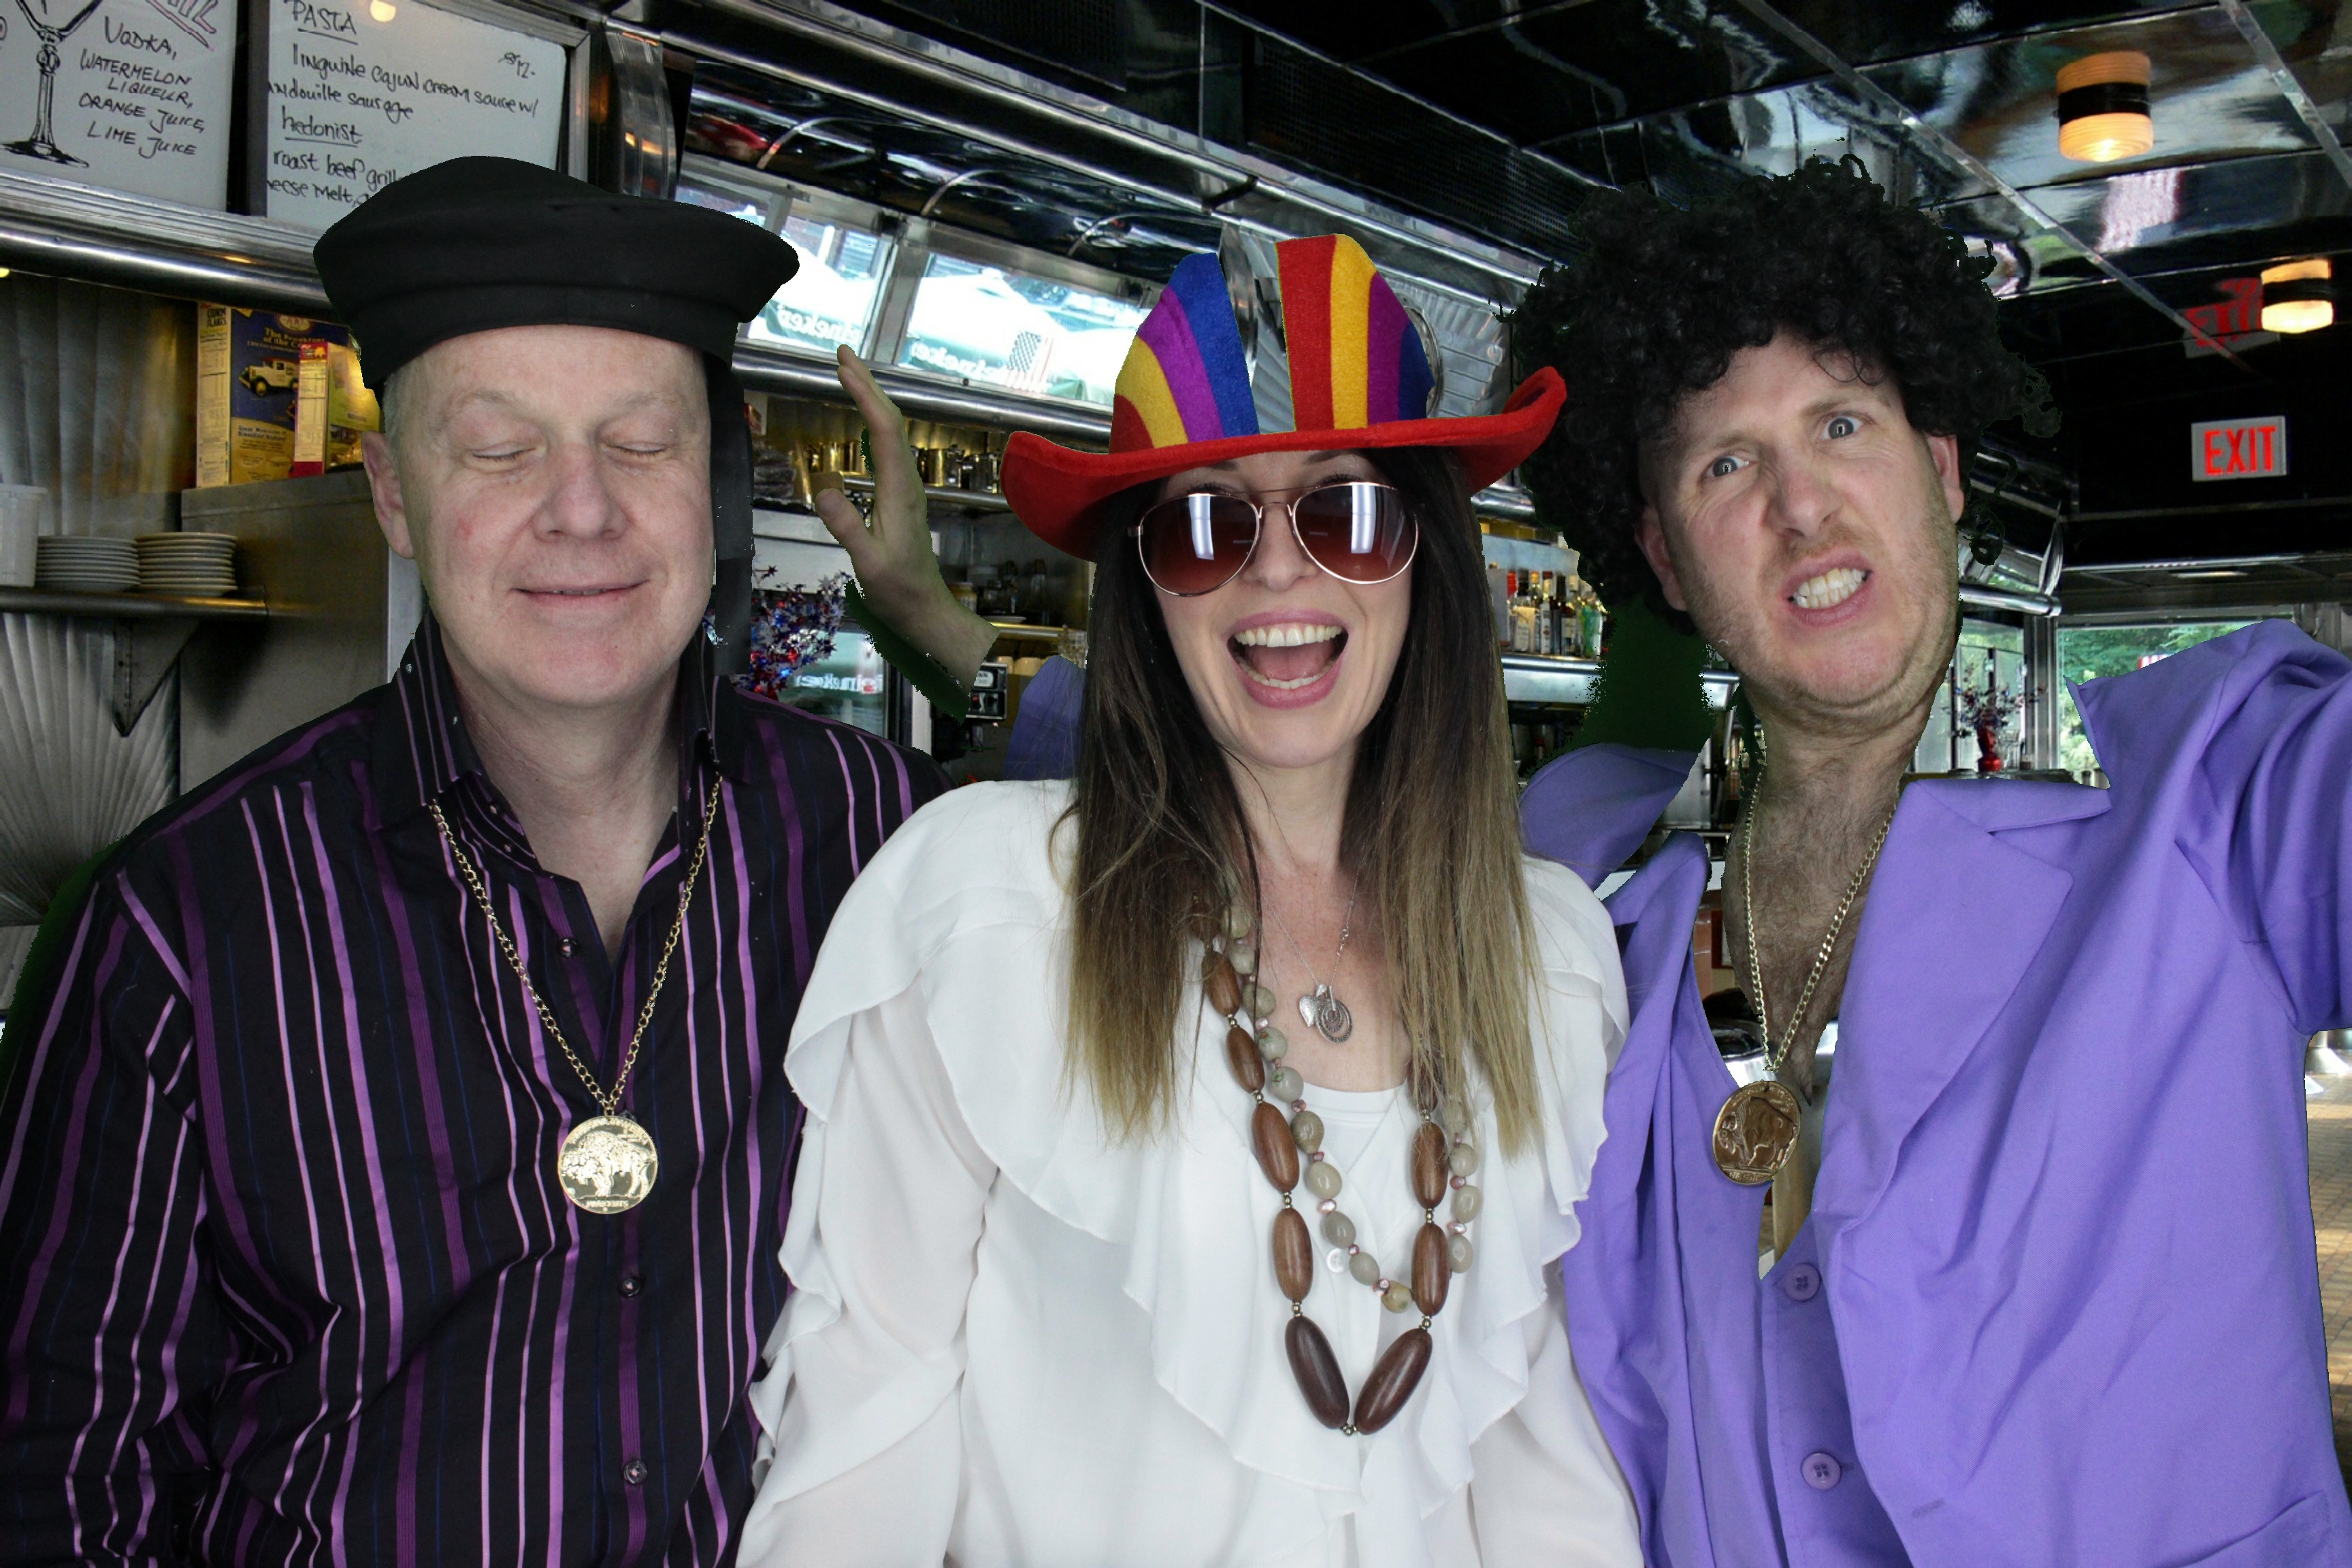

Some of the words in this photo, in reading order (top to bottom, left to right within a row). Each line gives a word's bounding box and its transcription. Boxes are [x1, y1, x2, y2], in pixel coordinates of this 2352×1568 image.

[283, 0, 357, 35] PASTA
[80, 48, 192, 85] WATERMELON
[78, 93, 146, 117] ORANGE
[150, 109, 205, 134] JUICE,
[282, 105, 363, 144] hedonist
[87, 121, 137, 144] LIME
[139, 137, 197, 159] JUICE
[274, 150, 318, 172] roast
[326, 154, 365, 180] beef
[2204, 424, 2277, 476] EXIT
